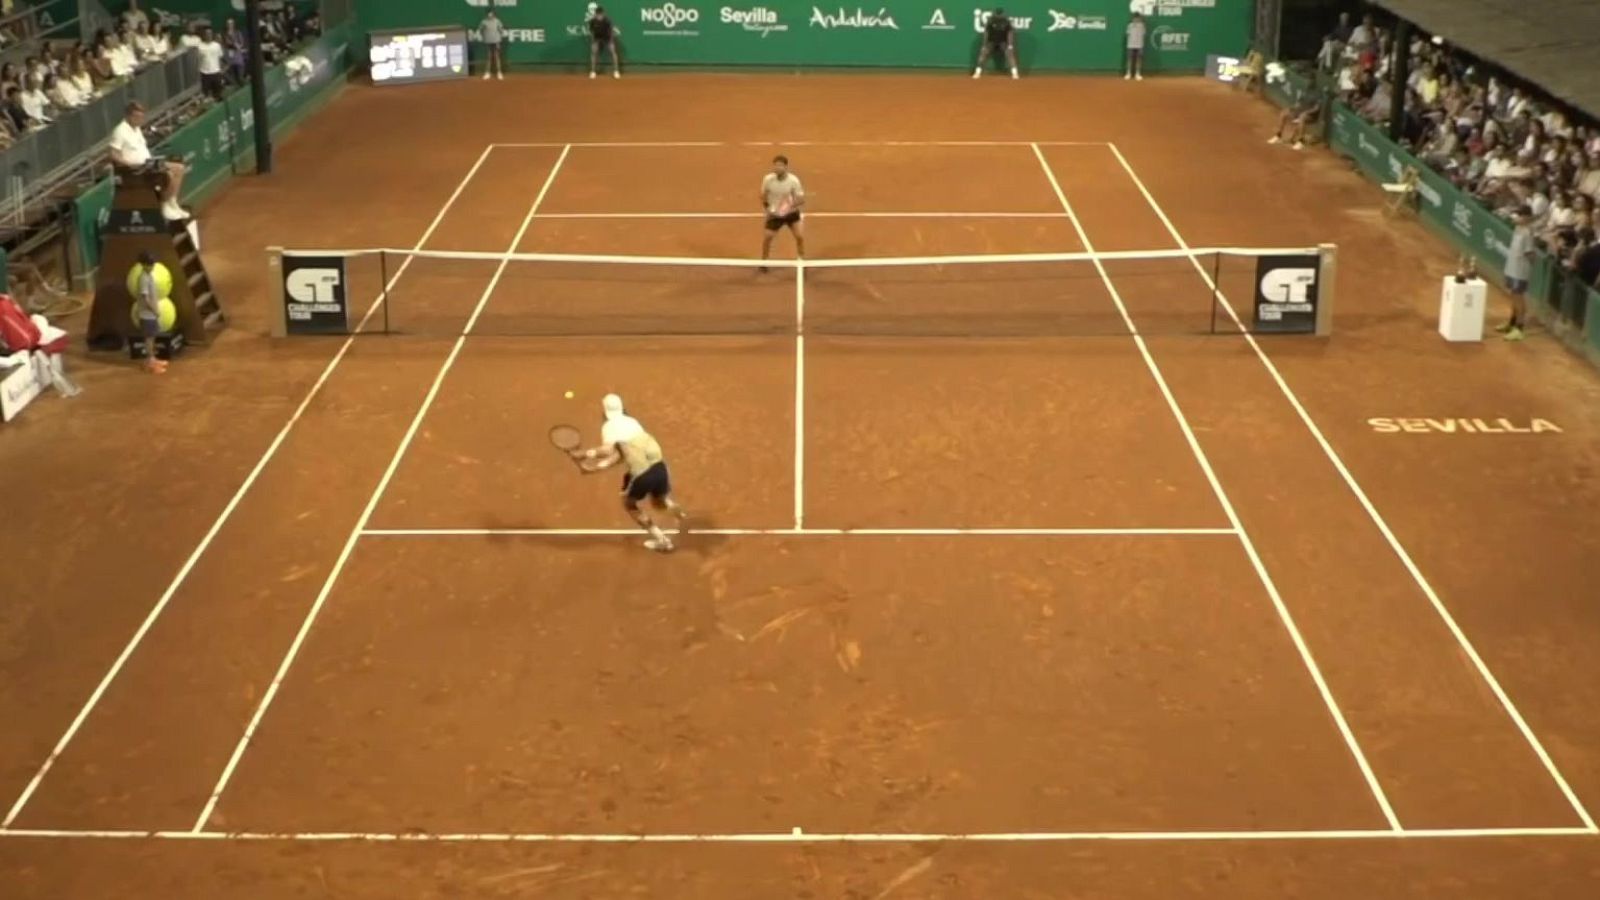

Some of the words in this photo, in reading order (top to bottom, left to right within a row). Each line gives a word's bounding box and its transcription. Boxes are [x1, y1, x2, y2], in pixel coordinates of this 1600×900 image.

[720, 6, 777, 23] Sevilla
[809, 6, 899, 29] Andalucía
[1367, 417, 1564, 433] SEVILLA
